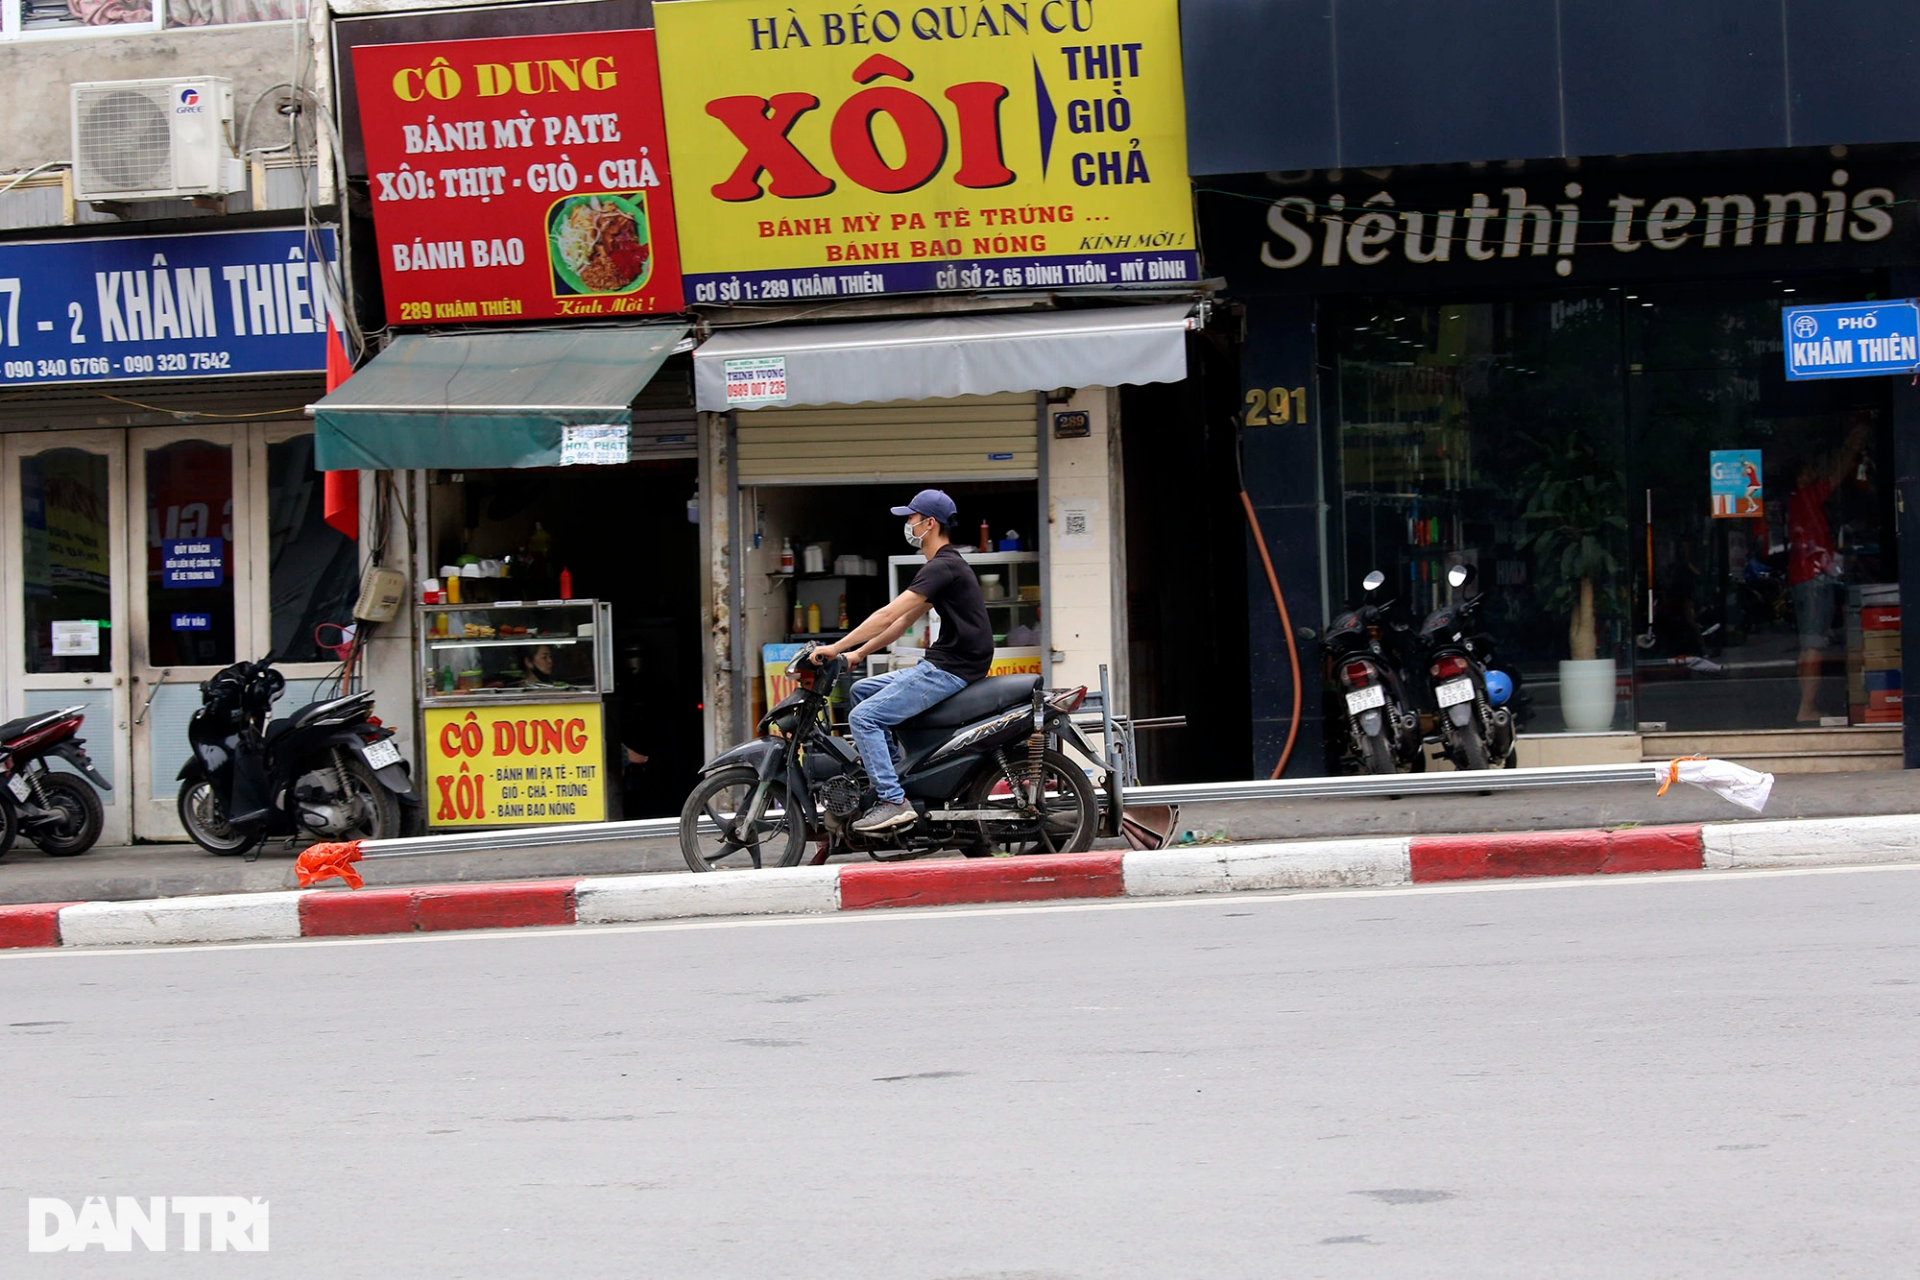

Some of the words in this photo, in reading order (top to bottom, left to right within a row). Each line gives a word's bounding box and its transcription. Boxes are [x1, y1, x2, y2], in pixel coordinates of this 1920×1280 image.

[747, 8, 812, 50] HÀ
[820, 3, 901, 46] BÉO
[911, 0, 1029, 40] QUÁN
[392, 56, 462, 102] CÔ
[473, 56, 618, 98] DUNG
[1061, 43, 1143, 86] THỊT
[704, 53, 1016, 203] XÔI
[1067, 89, 1131, 134] GIÒ
[402, 114, 488, 154] BÁNH
[491, 109, 536, 149] MỲ
[541, 112, 622, 146] PATE
[376, 162, 436, 202] XÔI:
[439, 166, 506, 203] THỊT
[527, 153, 578, 193] GIÒ
[598, 146, 660, 189] CHẢ
[1072, 138, 1151, 187] CHẢ
[758, 212, 832, 238] BÁNH
[842, 210, 881, 234] MỲ
[891, 212, 922, 231] PA
[934, 207, 971, 228] TÊ
[980, 202, 1074, 226] TRỨNG
[1608, 169, 1894, 252] tennis
[392, 237, 465, 272] BÁNH
[470, 237, 525, 269] BAO
[825, 237, 900, 262] BÁNH
[910, 238, 963, 258] BAO
[973, 231, 1047, 255] NÓNG
[1078, 233, 1132, 250] KÍNH
[695, 280, 717, 302] CƠ
[719, 275, 741, 300] SỞ
[761, 278, 790, 299] 289
[791, 273, 837, 298] KHÂM
[839, 270, 885, 294] THIÊN
[960, 262, 982, 288] SỞ
[984, 268, 1000, 287] 2:
[1002, 267, 1023, 286] 65
[1025, 263, 1063, 286] ĐÌNH
[1065, 260, 1107, 284] THÔN
[1120, 258, 1145, 281] MỸ
[1147, 256, 1187, 280] ĐÌNH
[68, 301, 86, 344] 2
[95, 253, 217, 342] KHÂM
[223, 246, 344, 337] THIÊN
[400, 301, 432, 320] 289
[435, 299, 478, 319] KHÂM
[480, 297, 523, 316] THIÊN
[555, 298, 605, 316] Kính
[1837, 310, 1878, 330] PHỐ
[4, 360, 35, 379] 090
[37, 359, 67, 377] 340
[70, 357, 109, 376] 6766
[123, 355, 154, 373] 090
[157, 353, 188, 371] 320
[189, 351, 231, 370] 7542
[1793, 336, 1853, 367] KHÂM
[1857, 332, 1917, 363] THIÊN
[727, 383, 748, 397] 0989
[751, 382, 767, 395] 007
[769, 381, 786, 394] 235
[1245, 387, 1307, 426] 291
[1060, 415, 1085, 428] 289
[440, 711, 484, 758] CÔ
[491, 718, 588, 757] DUNG
[496, 765, 523, 781] BÁNH
[541, 766, 553, 780] PA
[576, 765, 596, 781] THỊT
[527, 781, 547, 798] CHẢ
[436, 761, 486, 821] XÔI
[498, 802, 524, 817] BÁNH
[527, 803, 546, 816] BAO
[549, 800, 576, 816] NÓNG
